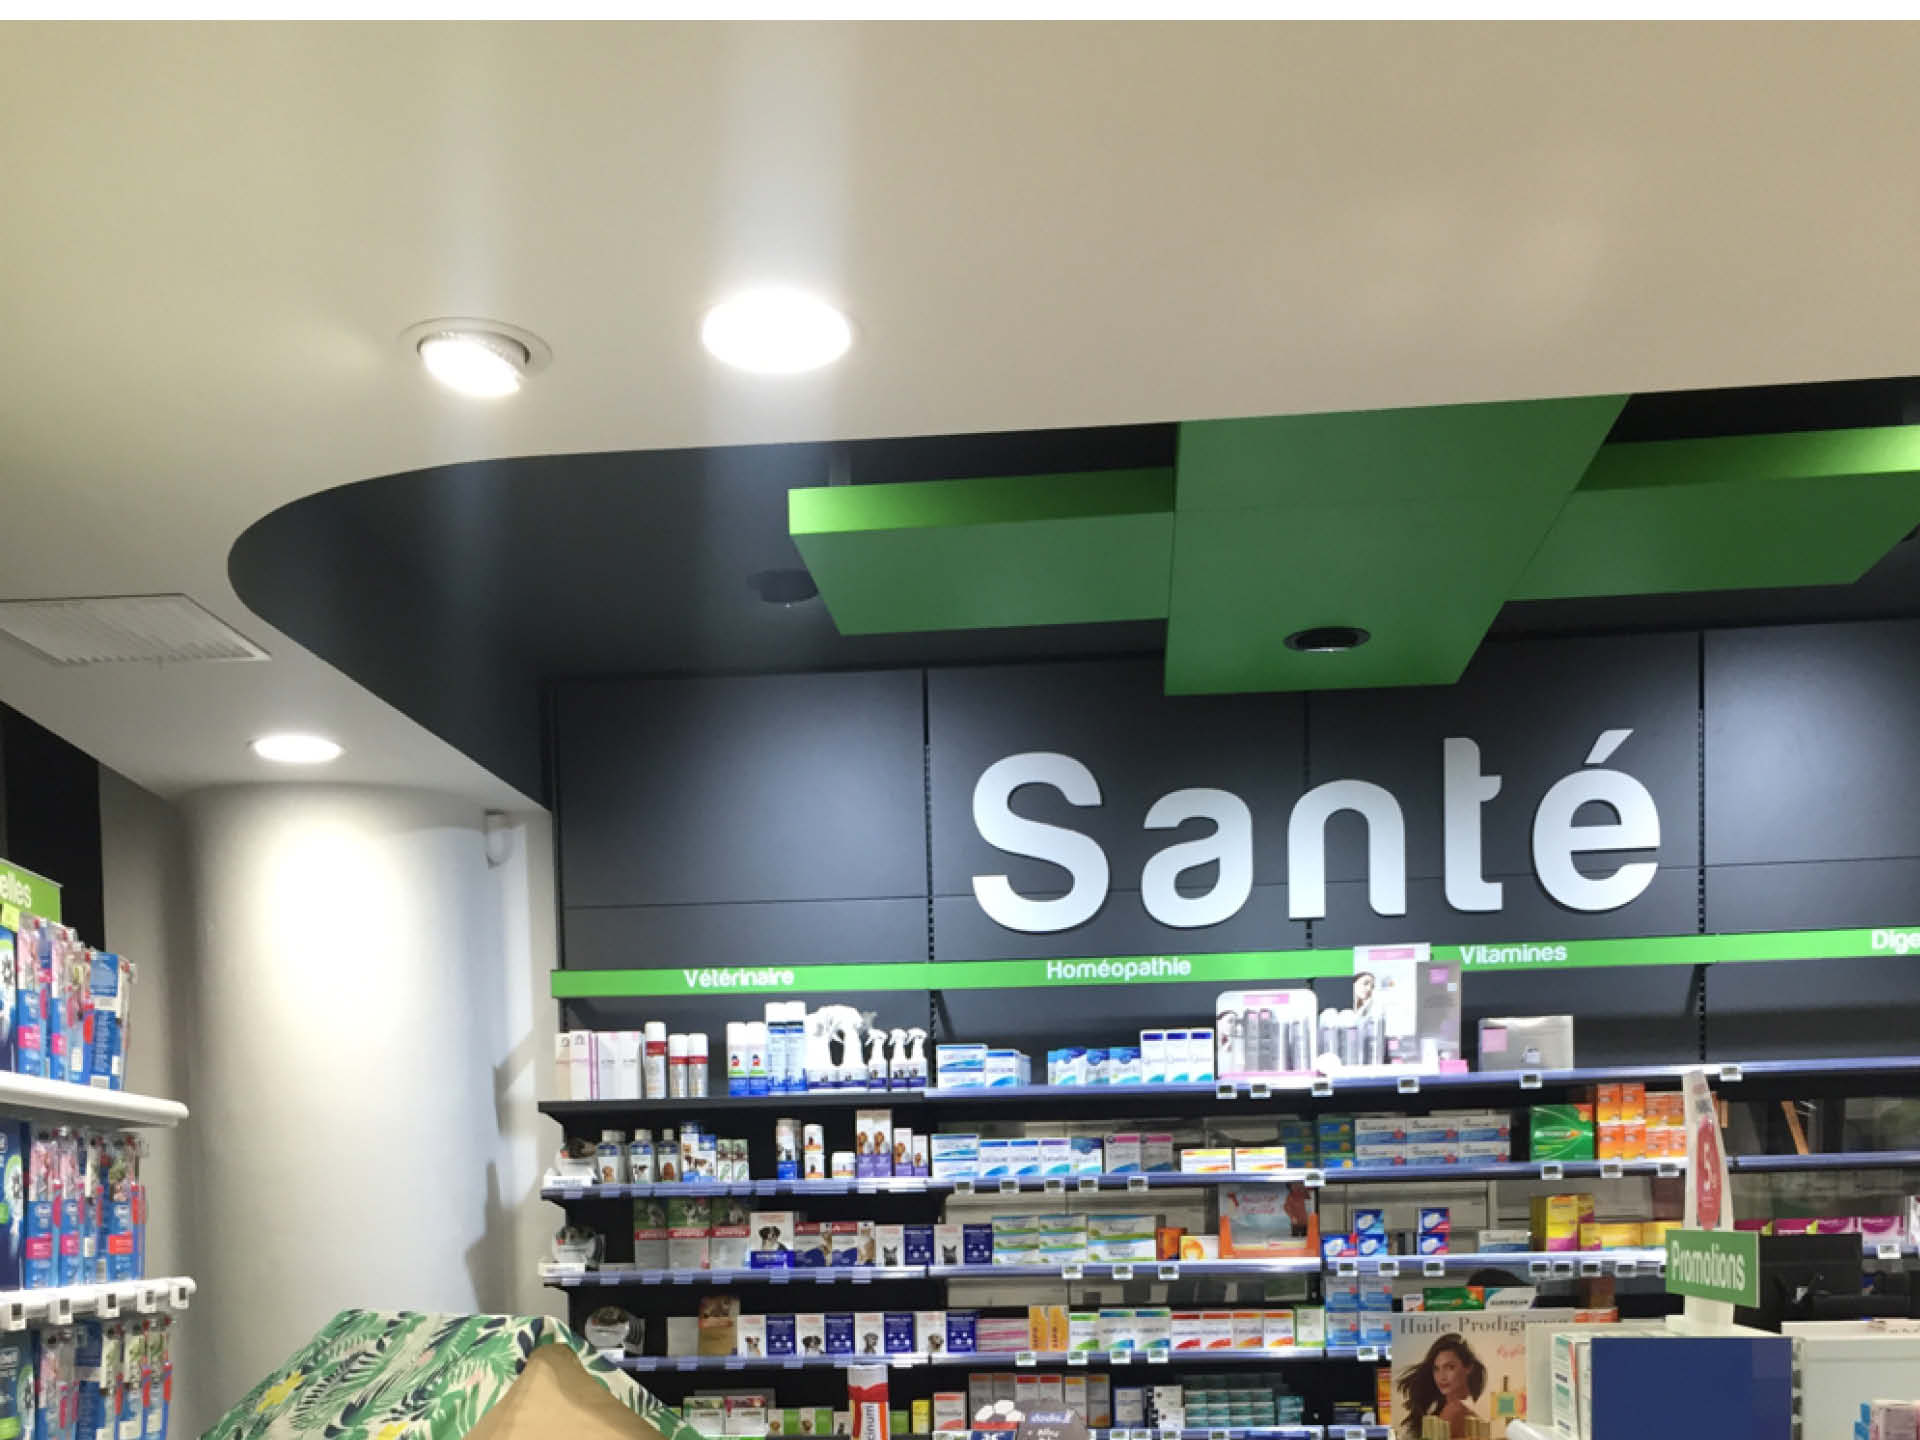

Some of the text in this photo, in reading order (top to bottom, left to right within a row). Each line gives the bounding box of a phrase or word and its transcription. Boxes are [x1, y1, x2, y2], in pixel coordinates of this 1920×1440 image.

[972, 729, 1661, 932] Santé
[1459, 943, 1568, 964] Vitamines
[683, 967, 795, 988] Vétérinaire
[1047, 957, 1192, 982] Homéopathie
[1671, 1240, 1745, 1291] Promotions
[1400, 1316, 1451, 1335] Huile
